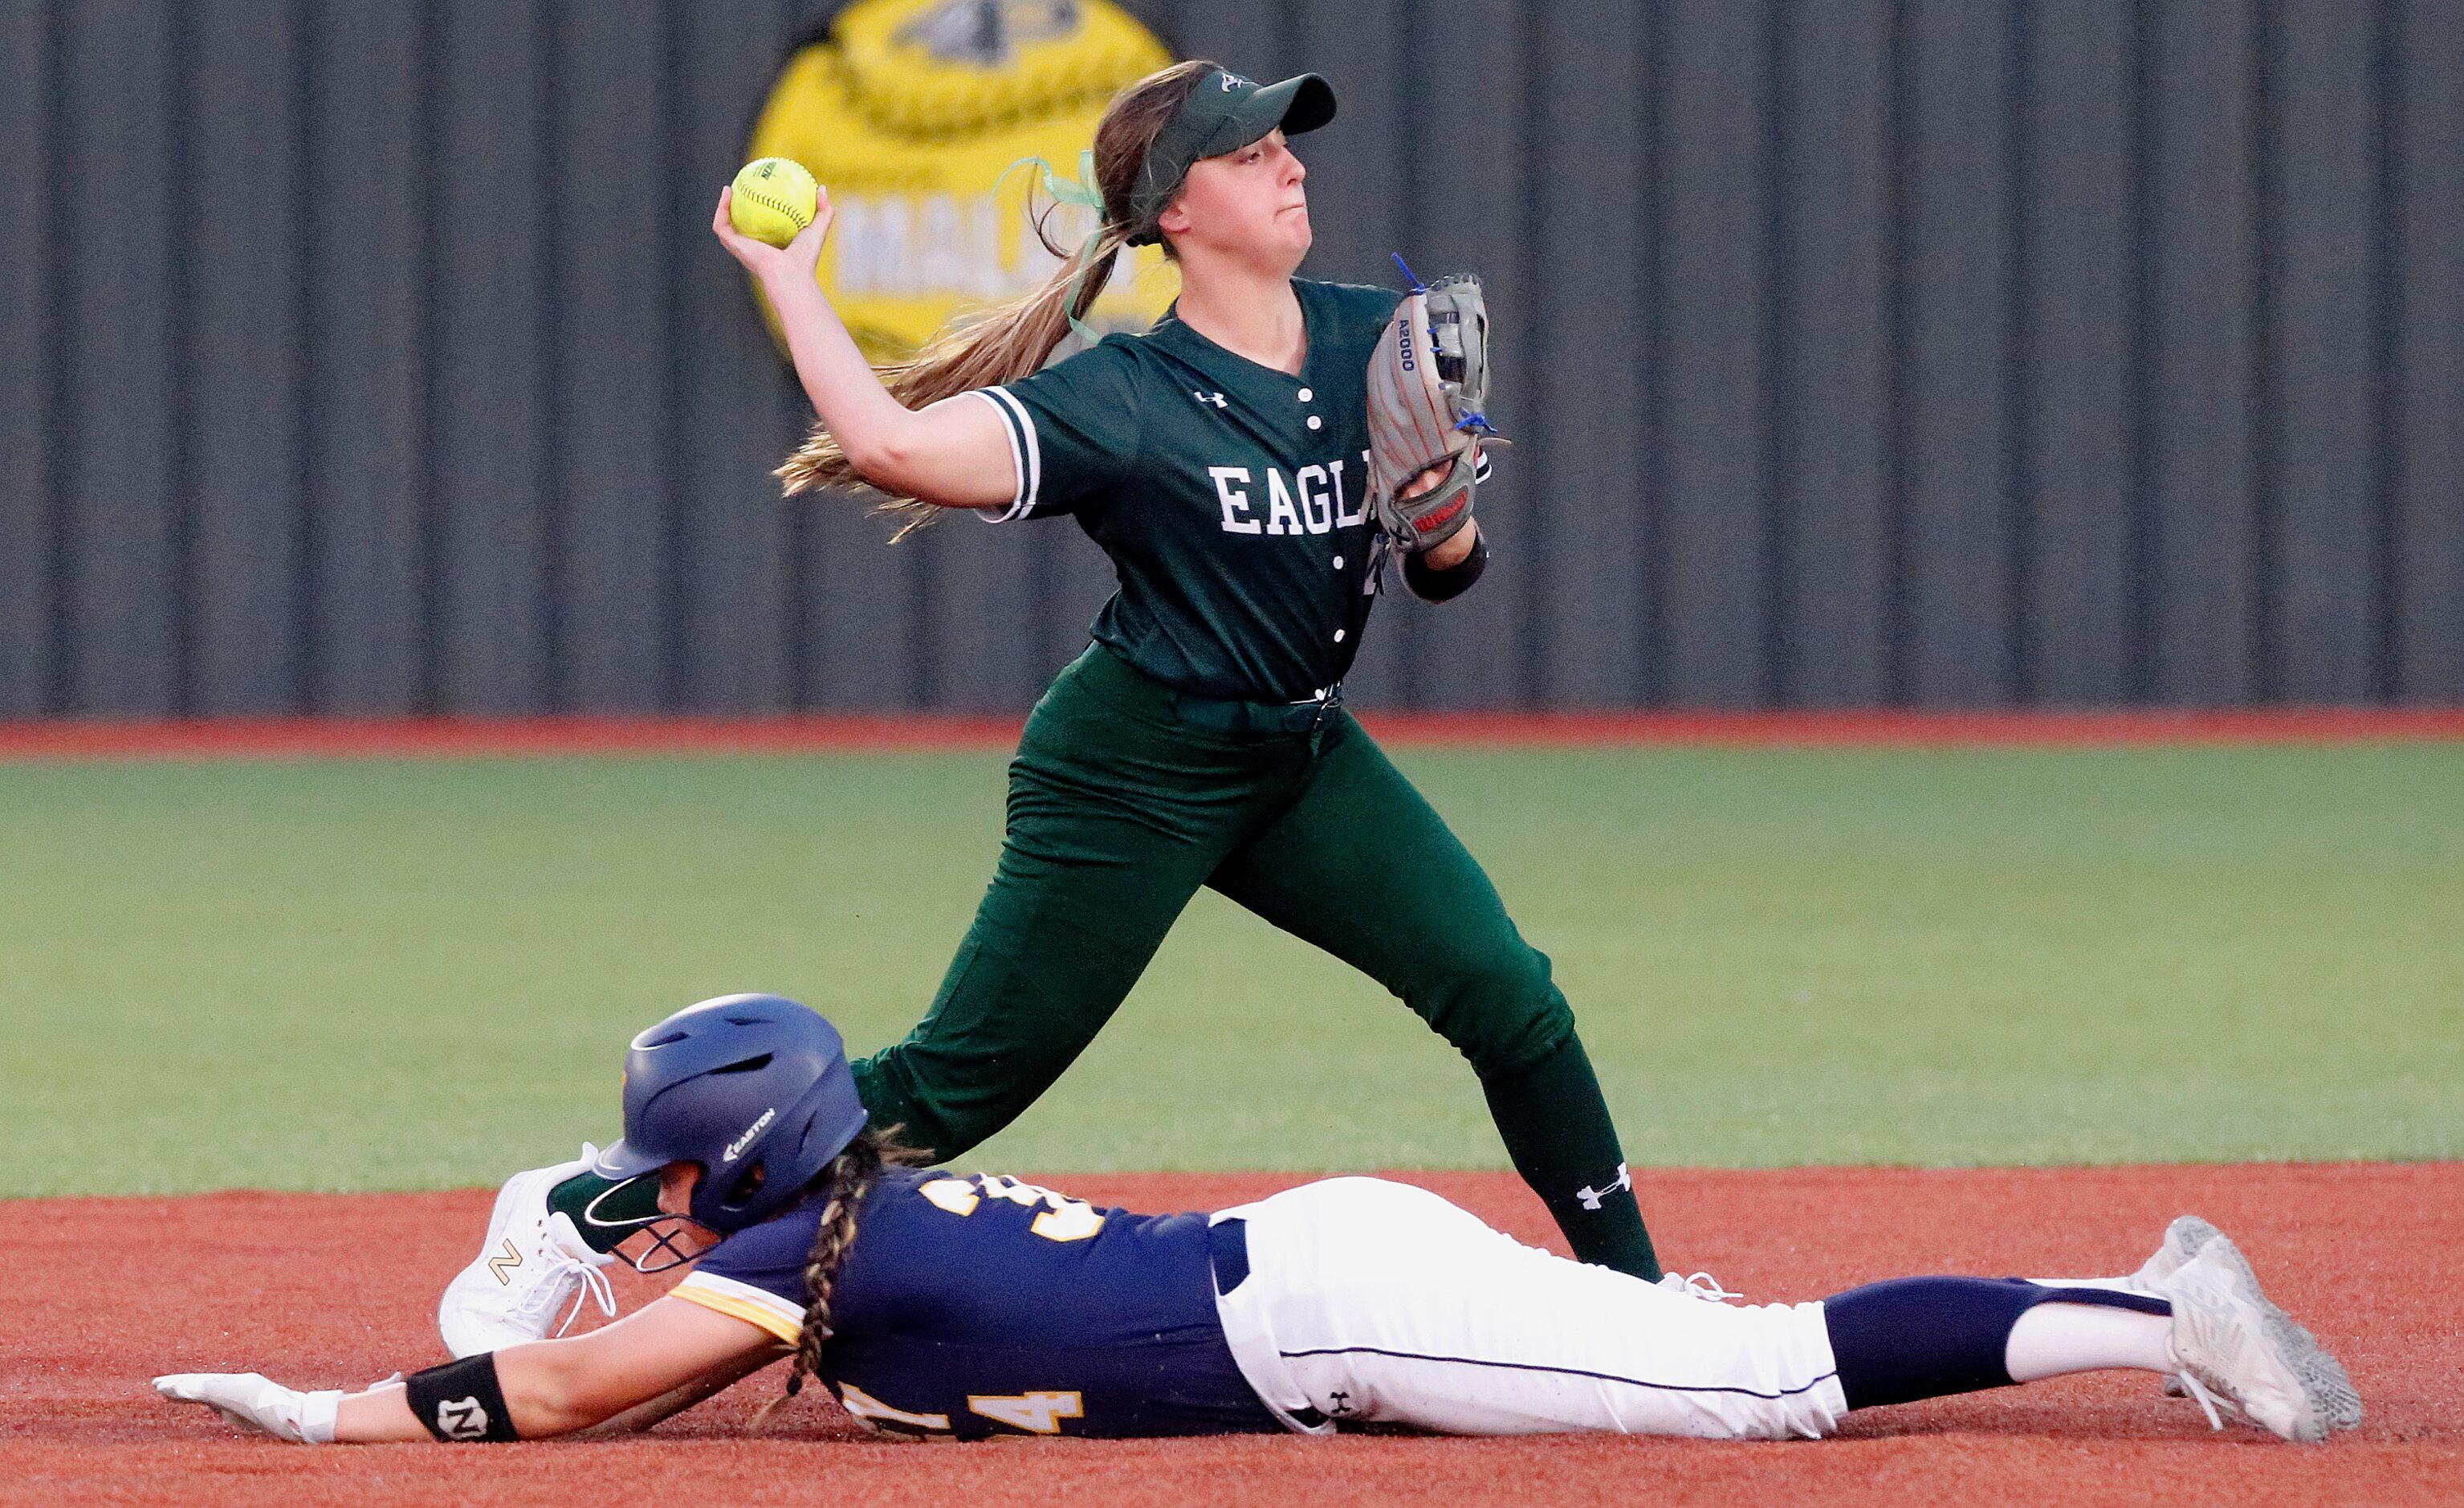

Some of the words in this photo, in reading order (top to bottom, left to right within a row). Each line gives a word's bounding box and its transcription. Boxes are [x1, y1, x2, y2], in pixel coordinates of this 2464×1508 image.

[1398, 319, 1414, 372] A2000
[1208, 449, 1370, 536] EAGL
[731, 1107, 776, 1151] EASTON
